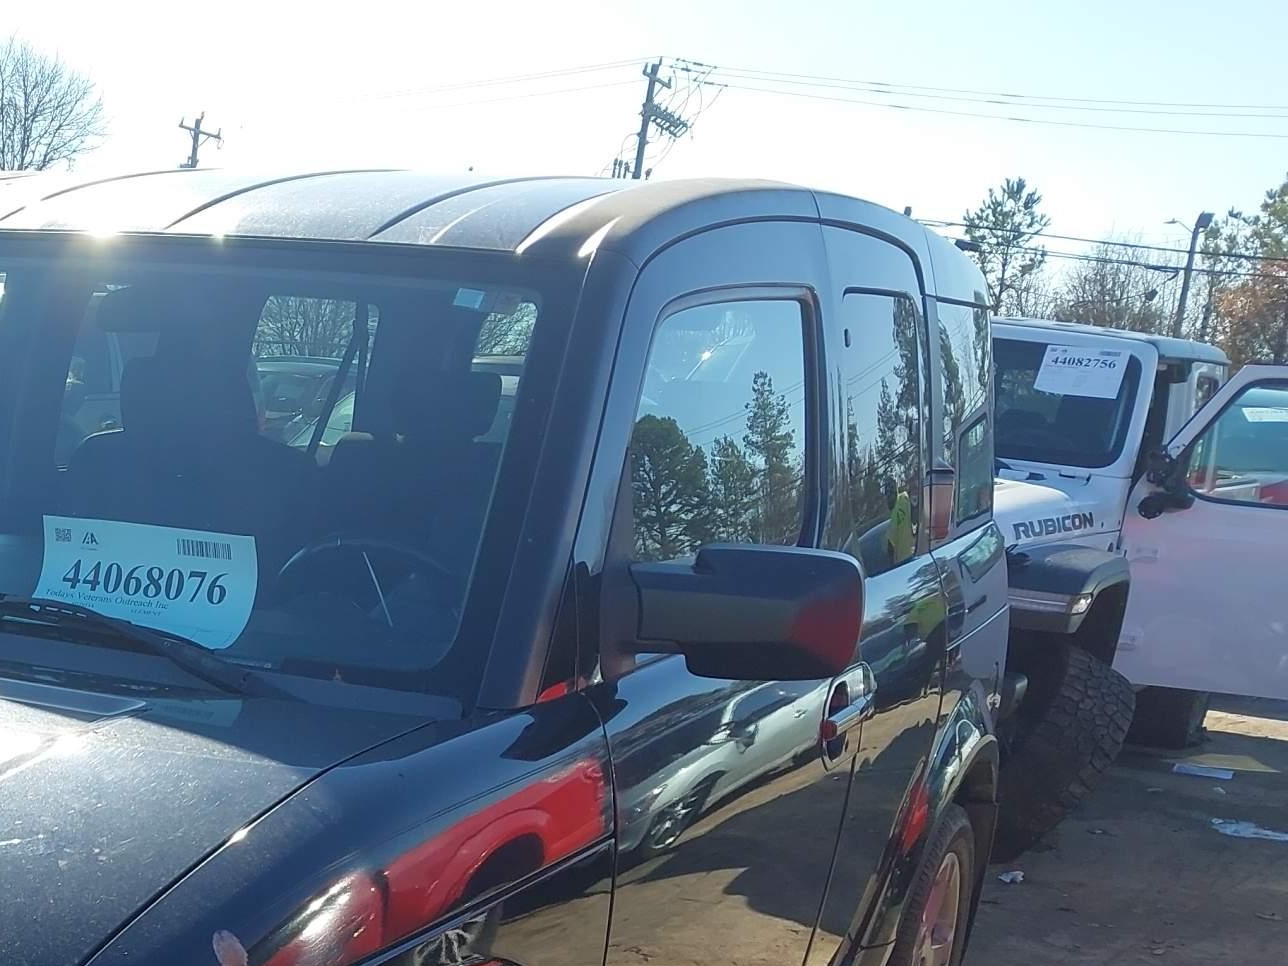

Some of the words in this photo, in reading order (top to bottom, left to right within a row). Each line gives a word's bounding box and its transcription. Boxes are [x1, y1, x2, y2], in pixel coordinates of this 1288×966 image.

[1051, 356, 1117, 369] 44082756
[1012, 511, 1094, 540] RUBICON
[62, 559, 230, 605] 44068076
[77, 591, 113, 602] Veterans
[114, 597, 153, 609] Outreach
[154, 600, 170, 610] Inc
